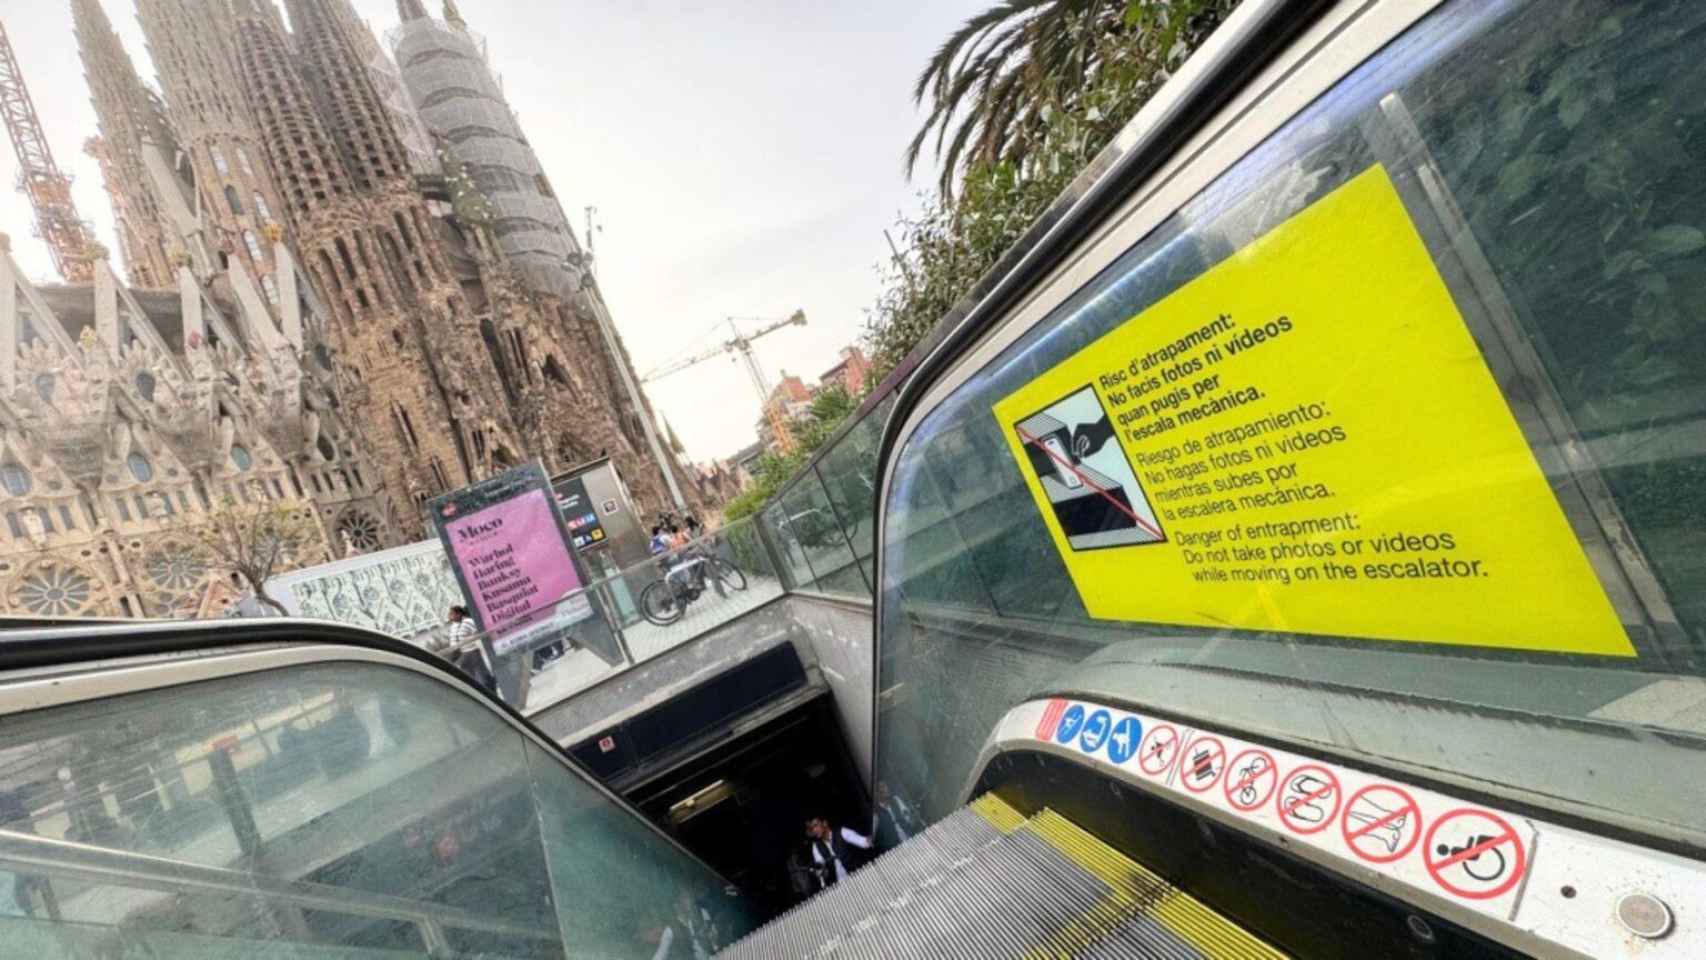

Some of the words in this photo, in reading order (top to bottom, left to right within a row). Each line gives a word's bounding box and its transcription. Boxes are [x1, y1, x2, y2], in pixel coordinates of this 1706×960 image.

[1099, 370, 1127, 390] Risc
[1128, 313, 1236, 376] d'atrapament:
[1108, 391, 1127, 408] No
[1127, 375, 1161, 399] facis
[1161, 357, 1203, 383] fotos
[1204, 344, 1223, 365] ni
[1224, 316, 1292, 355] vídeos
[1118, 405, 1149, 426] quan
[1150, 387, 1191, 415] pugis
[1192, 374, 1219, 399] per
[1124, 417, 1176, 442] l'escala
[1136, 446, 1181, 467] Riesgo
[1183, 438, 1202, 454] de
[1204, 401, 1330, 449] atrapamiento:
[1145, 471, 1165, 485] No
[1164, 461, 1208, 480] hagas
[1209, 449, 1253, 469] fotos
[1255, 440, 1274, 459] ni
[1155, 481, 1212, 502] mientras
[1214, 471, 1264, 492] subes
[1266, 462, 1298, 485] por
[1162, 507, 1176, 520] la
[1178, 499, 1237, 519] escalera
[458, 518, 503, 542] Moco
[1174, 530, 1222, 547] Danger
[1226, 524, 1243, 541] of
[1246, 512, 1360, 540] entrapment:
[468, 543, 514, 567] Warhol
[1183, 549, 1203, 564] Do
[1206, 548, 1229, 562] not
[1232, 545, 1266, 560] take
[1270, 541, 1337, 562] photos
[1341, 539, 1363, 555] or
[1370, 532, 1456, 553] videos
[473, 556, 516, 579] Haring
[478, 568, 520, 591] Banksy
[1193, 567, 1228, 582] while
[1231, 565, 1291, 584] moving
[1294, 566, 1319, 580] on
[1323, 561, 1358, 579] the
[1363, 557, 1489, 579] escalator.
[482, 576, 531, 602] Kusama
[486, 585, 539, 613] Basquiat
[491, 599, 531, 624] Digital
